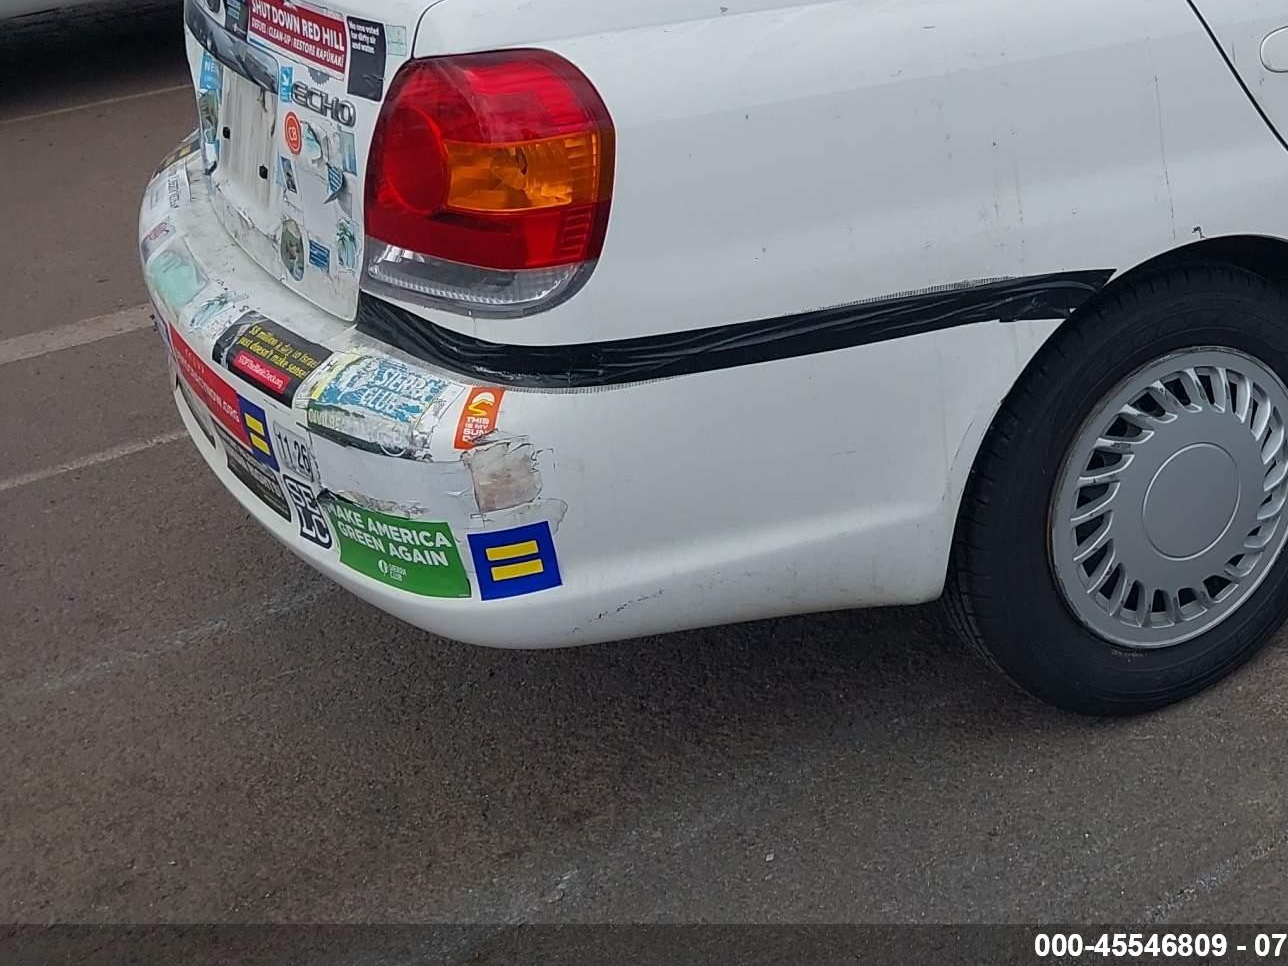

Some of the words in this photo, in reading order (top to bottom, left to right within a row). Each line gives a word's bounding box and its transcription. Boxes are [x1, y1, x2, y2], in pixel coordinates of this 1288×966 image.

[272, 6, 300, 35] DOWN
[302, 19, 321, 42] RED
[321, 26, 345, 51] HILL
[365, 25, 380, 36] voted
[269, 26, 291, 44] CLEAN-UP
[293, 38, 315, 55] RESTORE
[352, 41, 361, 50] and
[291, 81, 356, 127] ECHO
[288, 126, 298, 141] CB
[270, 352, 289, 368] make
[466, 416, 490, 425] THIS
[277, 433, 294, 465] 11
[294, 440, 312, 476] 26
[324, 502, 365, 529] MAKE
[367, 518, 453, 549] AMERICA
[337, 521, 386, 554] GREEN
[389, 543, 449, 566] AGAIN
[389, 572, 403, 582] CLUB
